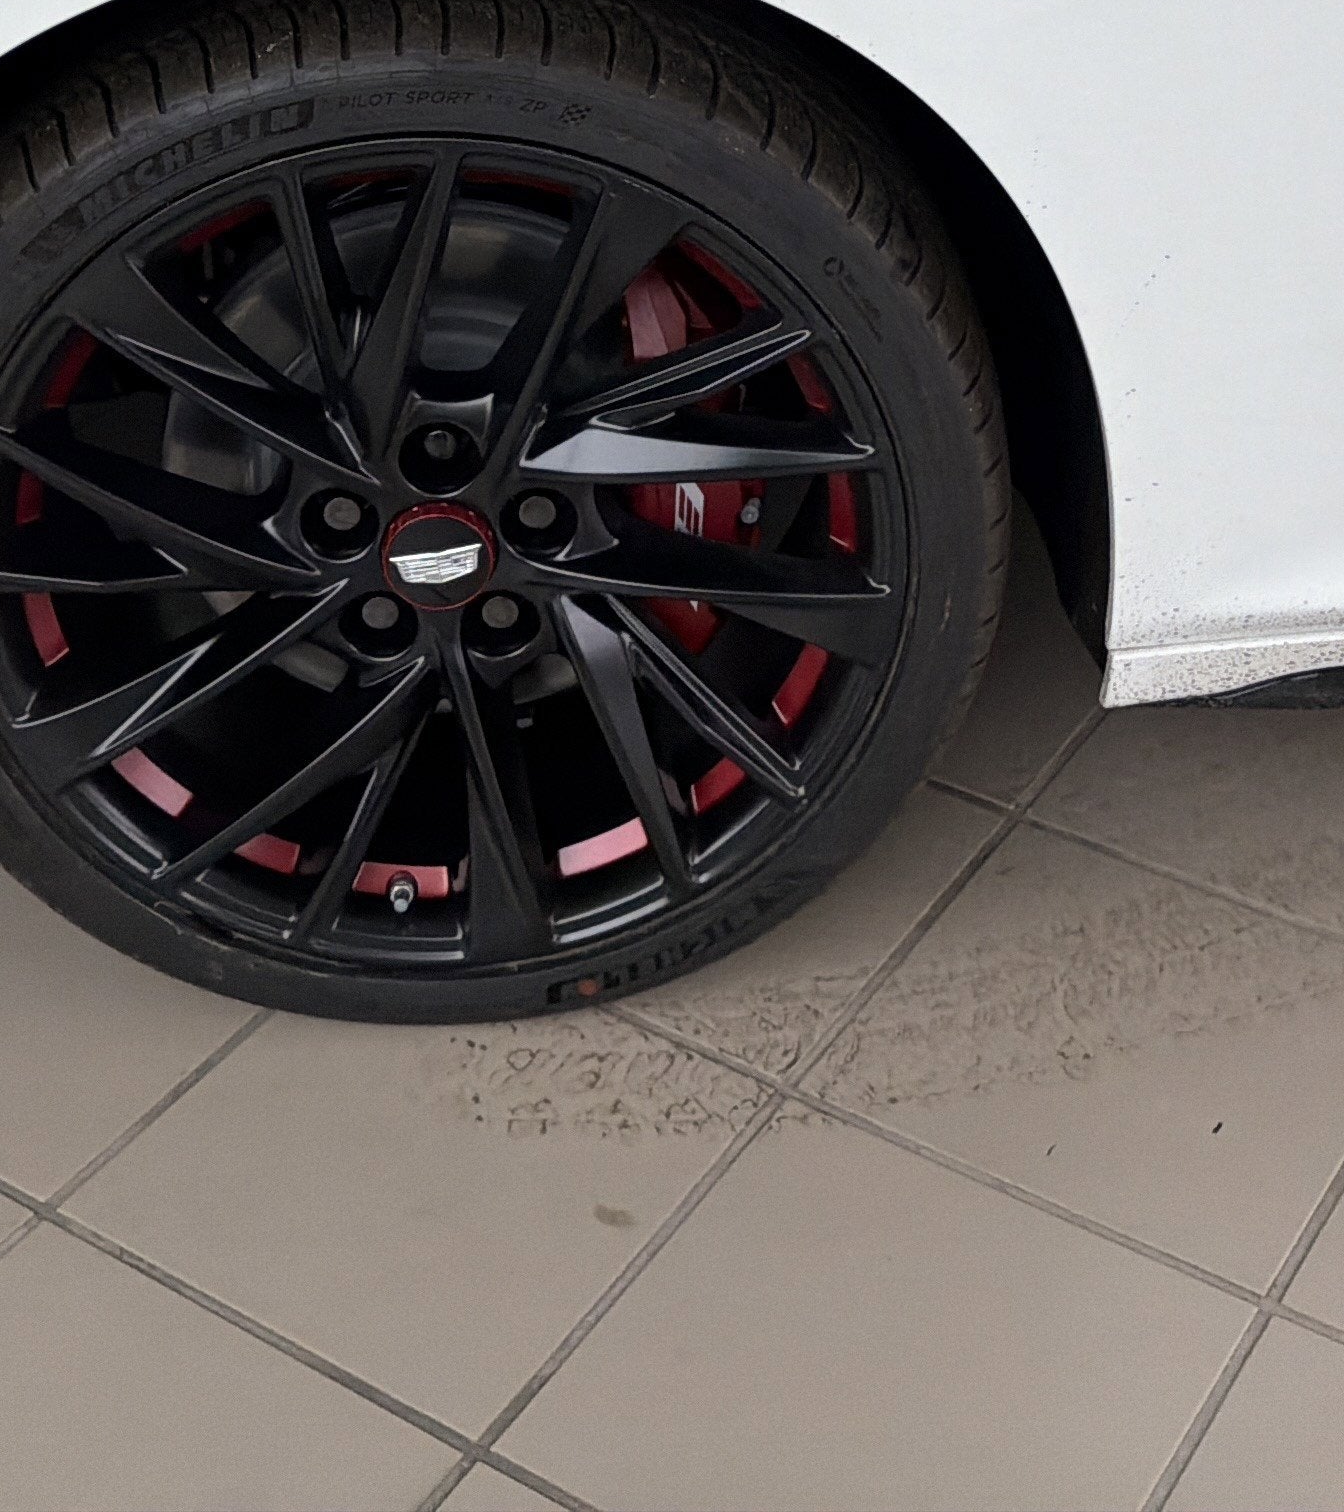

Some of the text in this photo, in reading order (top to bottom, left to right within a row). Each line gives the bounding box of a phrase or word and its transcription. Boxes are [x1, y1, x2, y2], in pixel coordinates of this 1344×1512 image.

[75, 99, 299, 229] MICHELIN
[339, 91, 398, 109] PILOT
[405, 90, 475, 105] SPORT
[519, 98, 549, 113] ZP
